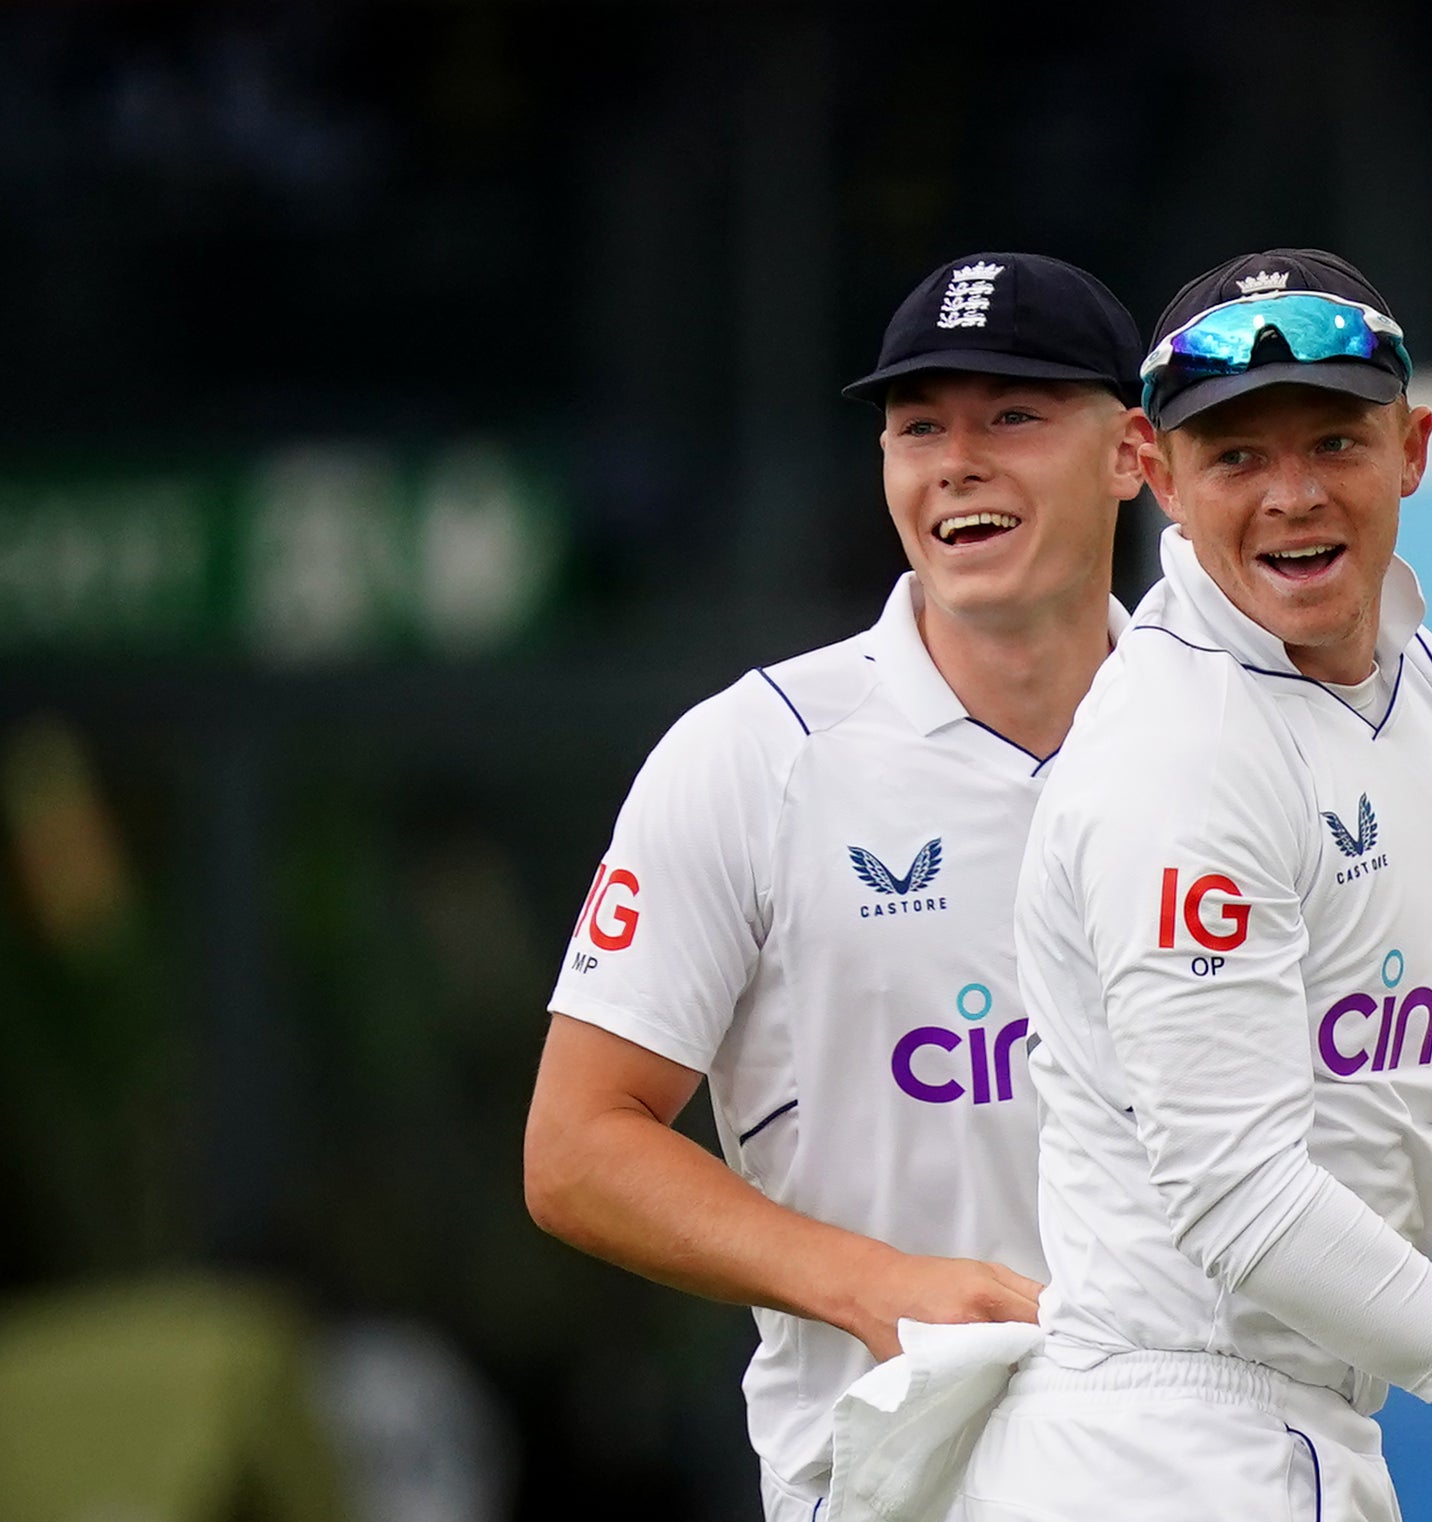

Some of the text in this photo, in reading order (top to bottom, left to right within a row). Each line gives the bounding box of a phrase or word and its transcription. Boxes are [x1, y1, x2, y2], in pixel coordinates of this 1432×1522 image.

[574, 862, 640, 951] IG
[860, 897, 948, 918] CASTORE
[1158, 867, 1252, 952] IG
[571, 951, 598, 974] MP
[1190, 955, 1226, 977] OP
